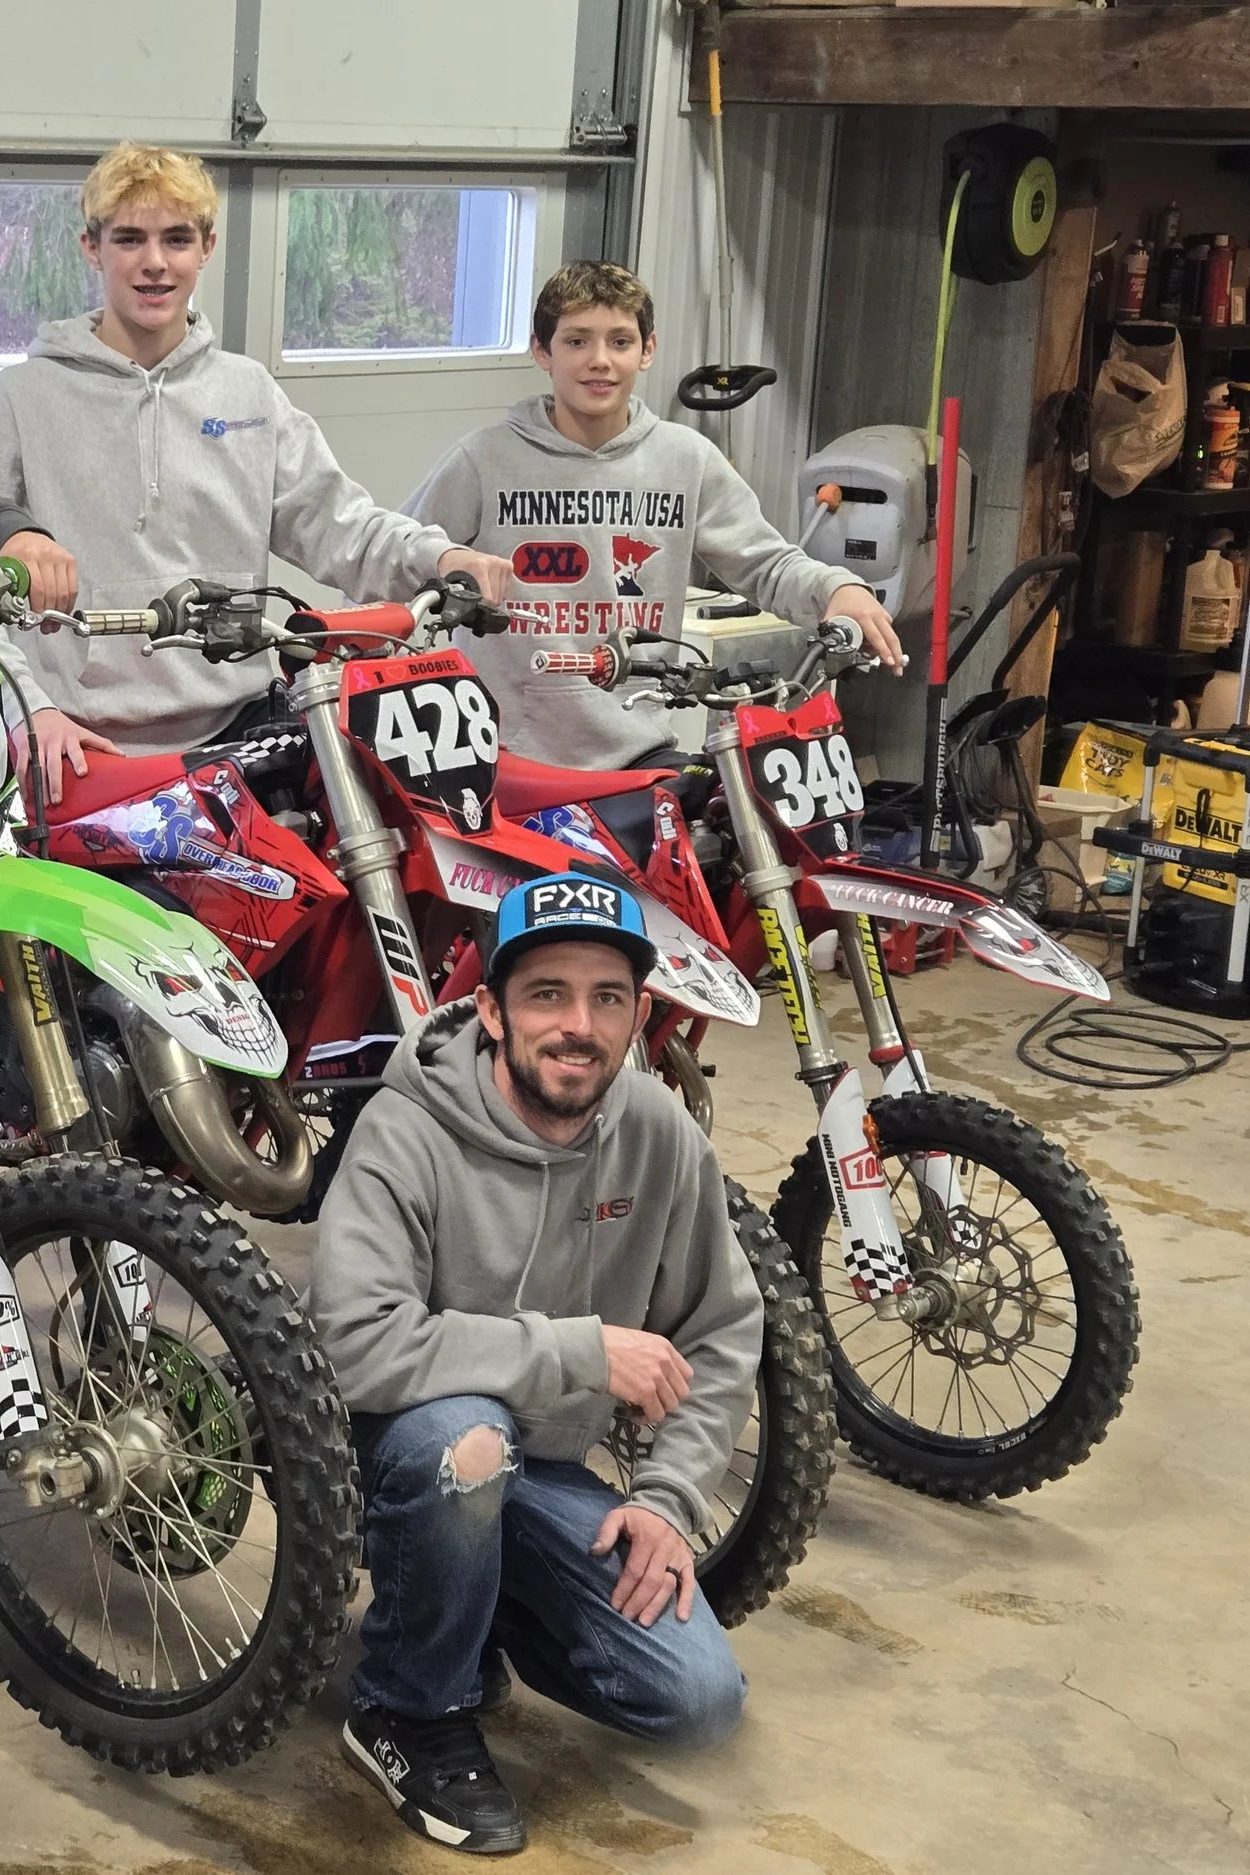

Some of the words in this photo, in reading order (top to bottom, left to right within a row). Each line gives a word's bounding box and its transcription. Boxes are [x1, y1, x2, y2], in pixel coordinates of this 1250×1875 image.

[497, 490, 685, 529] MINNESOTA/USA
[521, 546, 583, 578] XXL
[408, 660, 459, 676] BOOBIES
[375, 679, 498, 777] 428
[763, 734, 864, 828] 348
[449, 862, 495, 895] FUCK
[533, 883, 616, 916] FXR
[881, 890, 955, 917] CANCER
